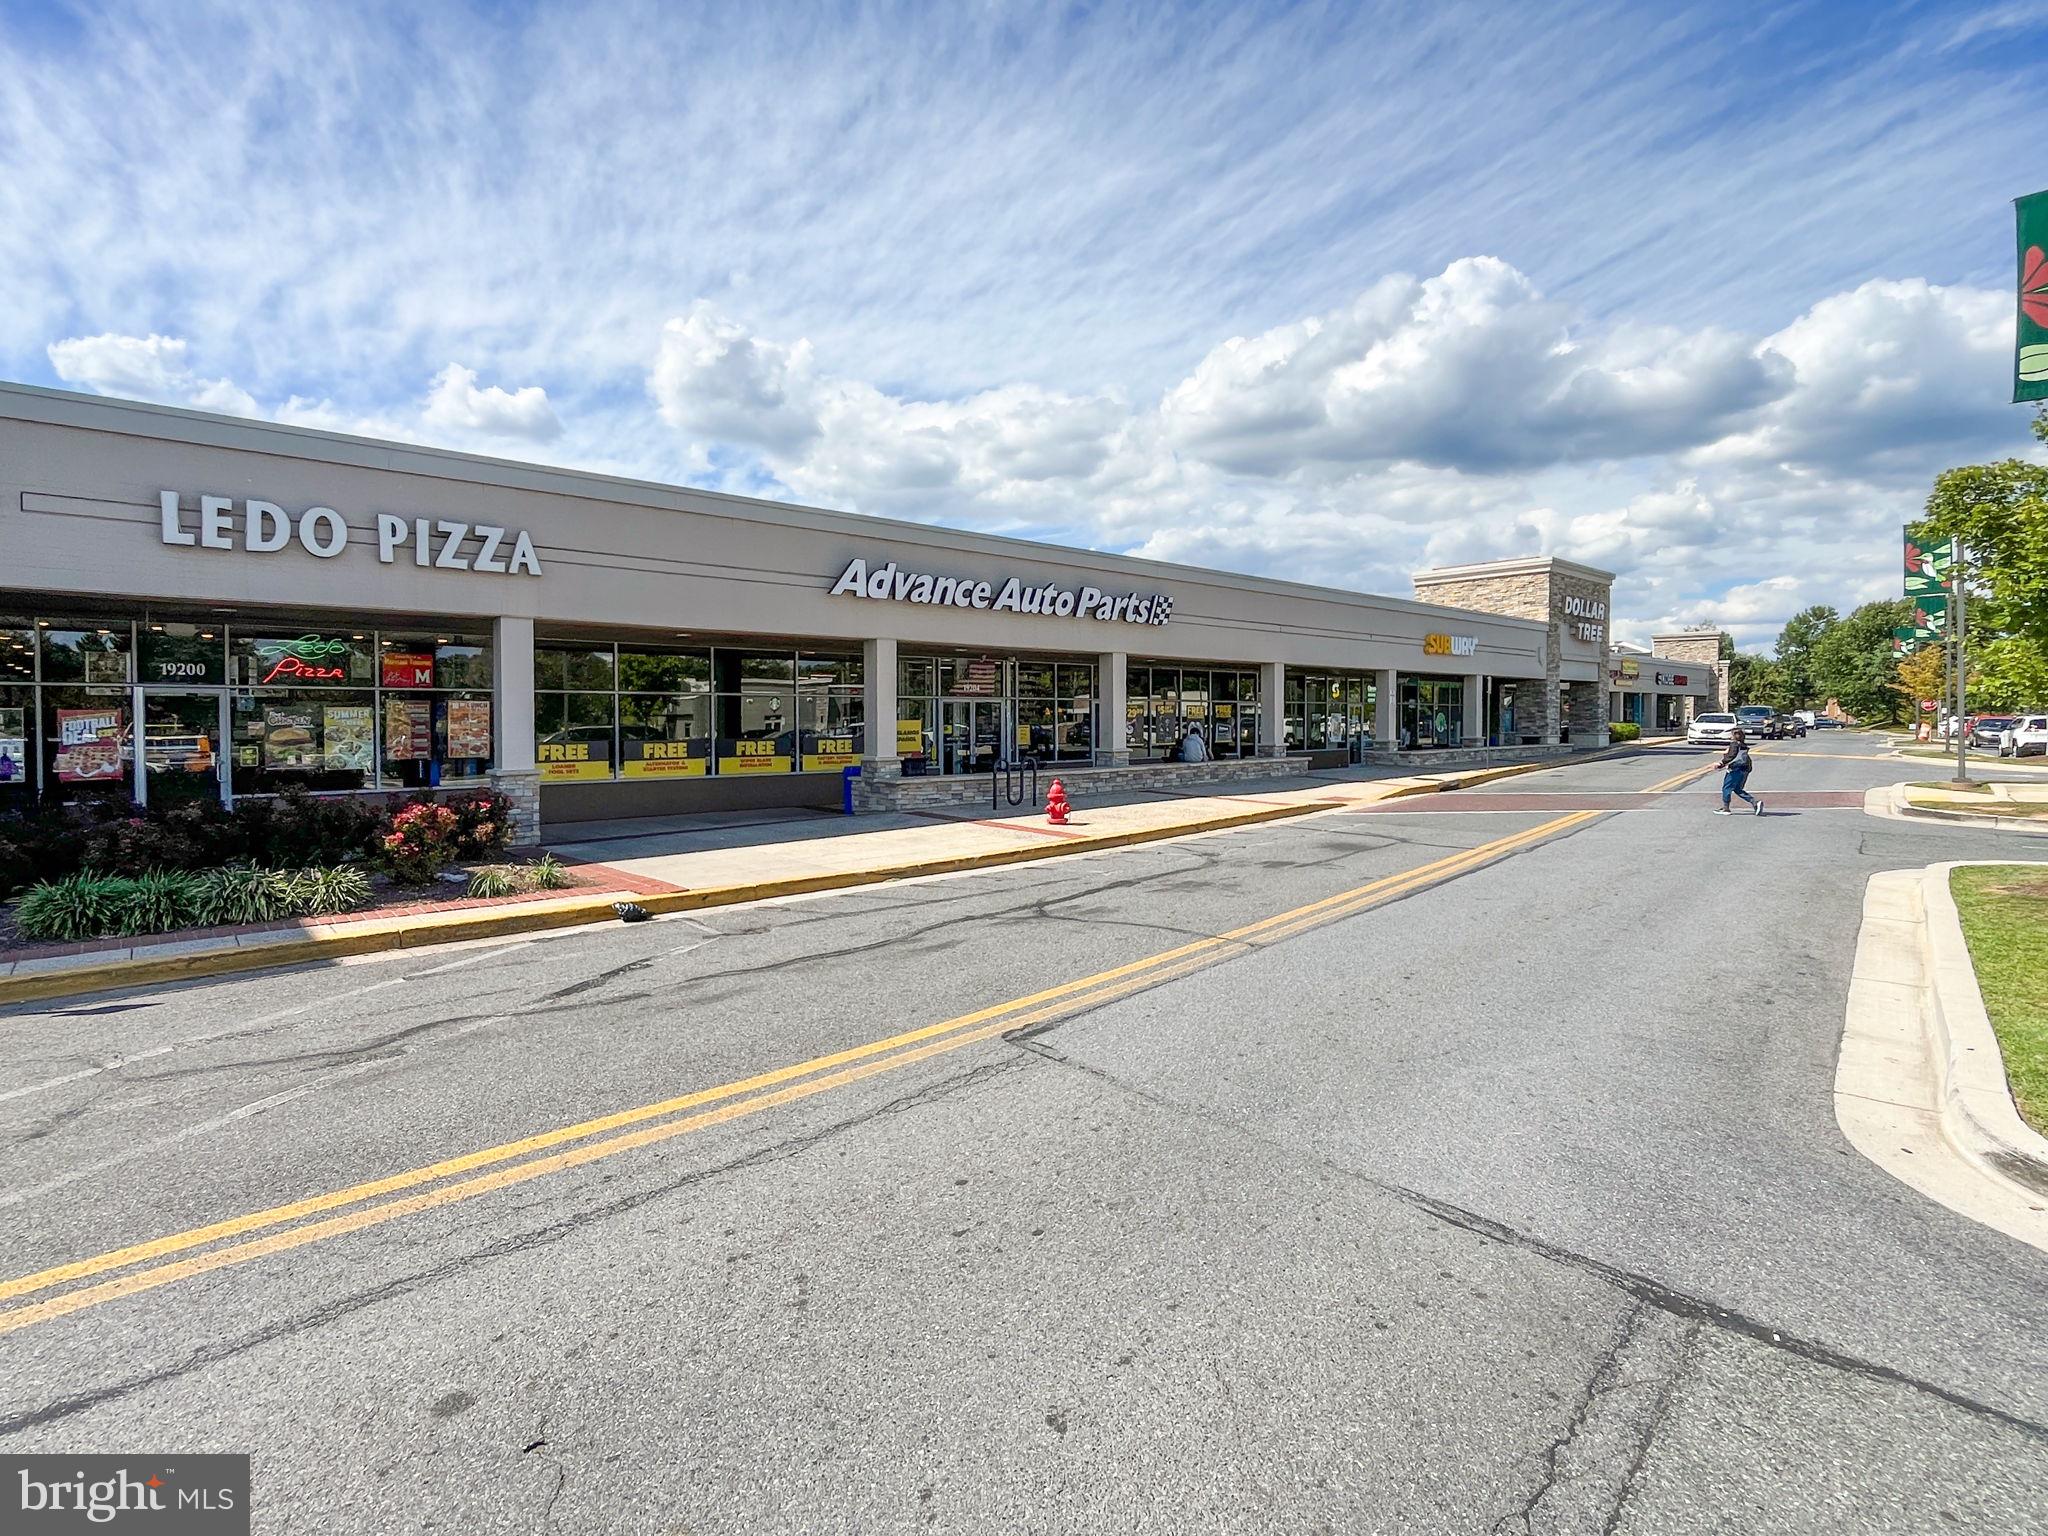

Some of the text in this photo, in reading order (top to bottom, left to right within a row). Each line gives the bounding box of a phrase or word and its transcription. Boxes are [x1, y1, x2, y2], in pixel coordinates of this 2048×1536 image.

[159, 490, 543, 576] LEDO PIZZA
[830, 558, 1151, 624] Advance Auto Parts
[1564, 596, 1605, 620] DOLLAR
[1577, 622, 1604, 642] TREE
[261, 634, 346, 660] Ledo
[1424, 632, 1478, 656] SUBWAY
[159, 662, 206, 676] 19200
[263, 657, 344, 684] Pizza
[415, 669, 431, 684] M
[327, 709, 370, 719] SUMMER
[1187, 706, 1204, 716] FREE
[538, 743, 589, 761] FREE
[643, 742, 688, 759] FREE
[736, 740, 775, 756] FREE
[817, 739, 853, 754] FREE
